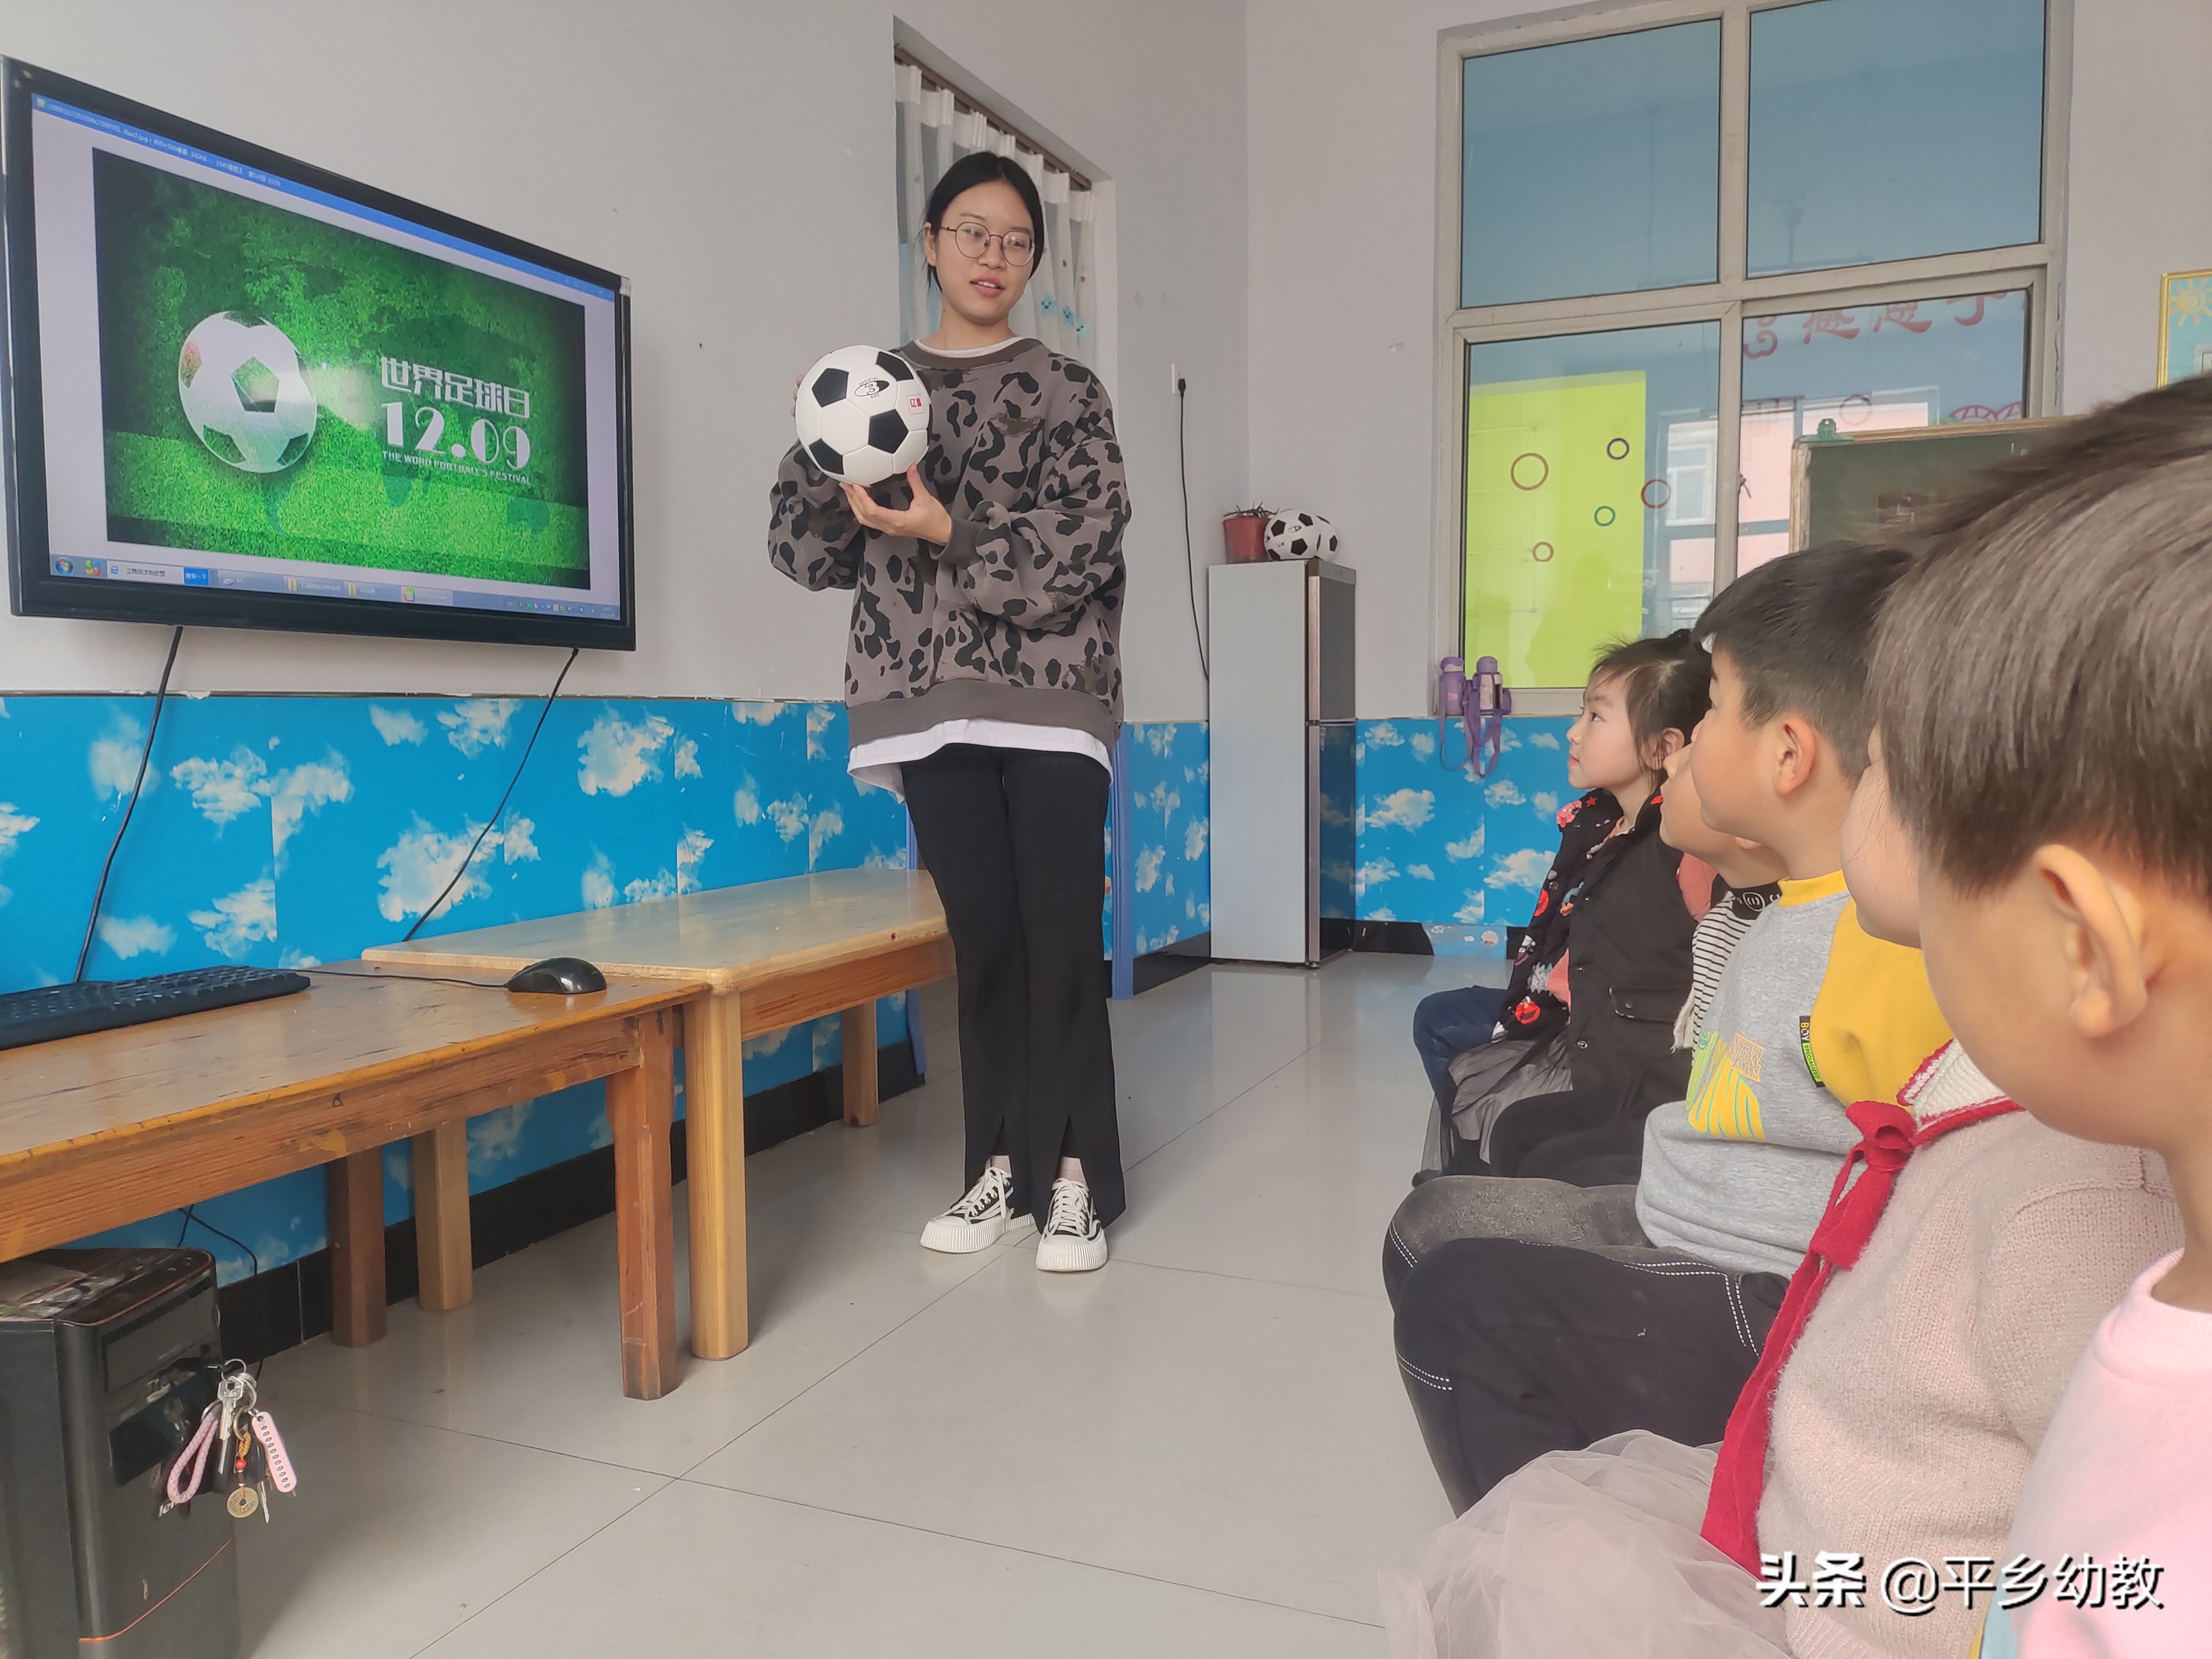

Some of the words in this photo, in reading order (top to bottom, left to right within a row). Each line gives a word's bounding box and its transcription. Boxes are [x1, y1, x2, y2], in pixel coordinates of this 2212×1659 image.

[380, 357, 530, 419] 世界足球日
[382, 402, 530, 469] 12.09
[383, 451, 402, 462] THE
[1801, 1022, 1809, 1042] BOY
[1804, 1045, 1820, 1079] SPECIALIZED
